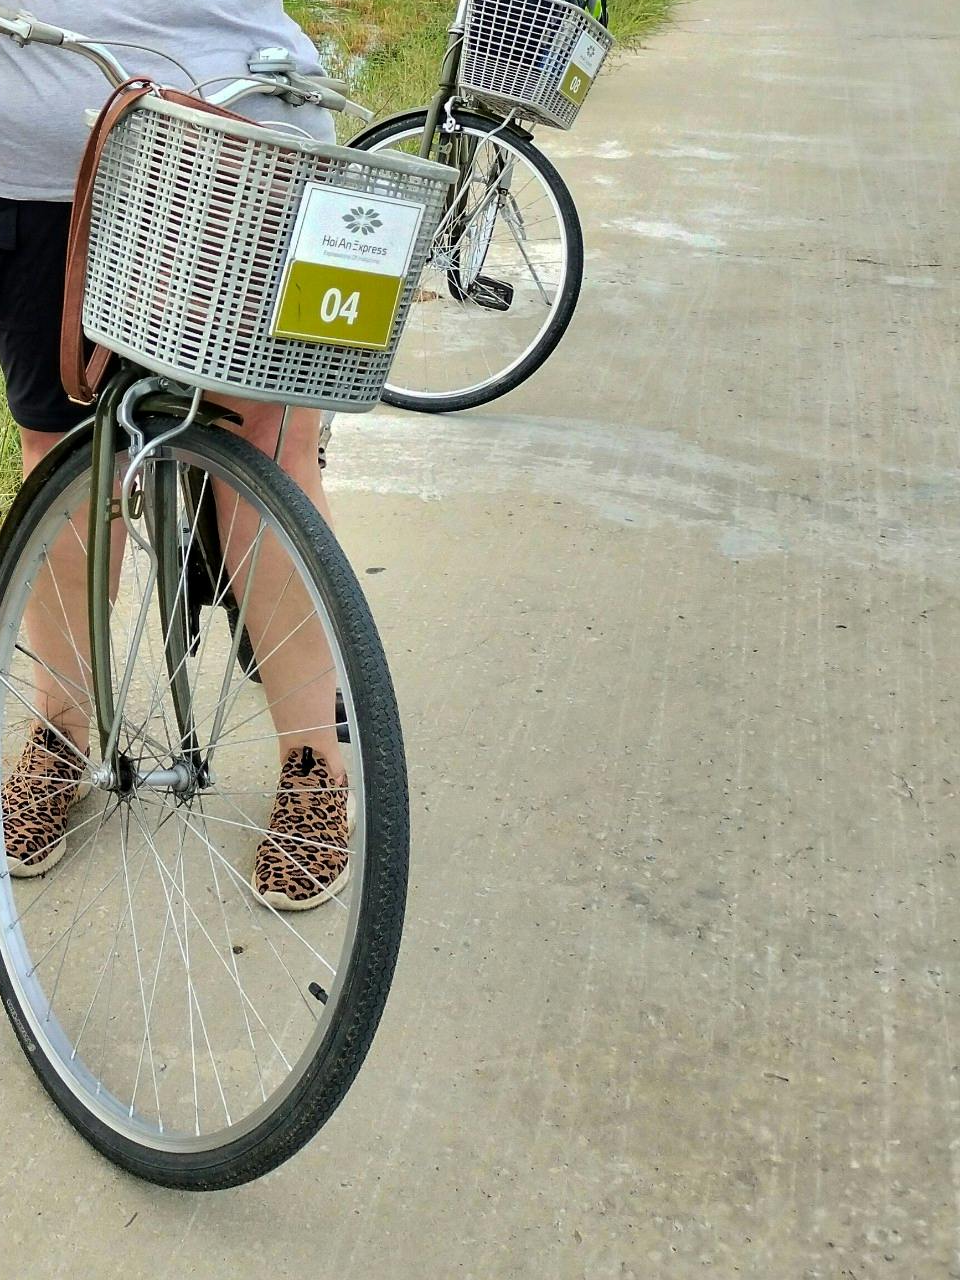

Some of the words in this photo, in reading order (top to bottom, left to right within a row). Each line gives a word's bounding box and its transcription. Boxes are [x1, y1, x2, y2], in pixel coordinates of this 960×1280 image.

[570, 76, 581, 94] 08
[353, 240, 388, 256] Express
[320, 287, 360, 325] 04
